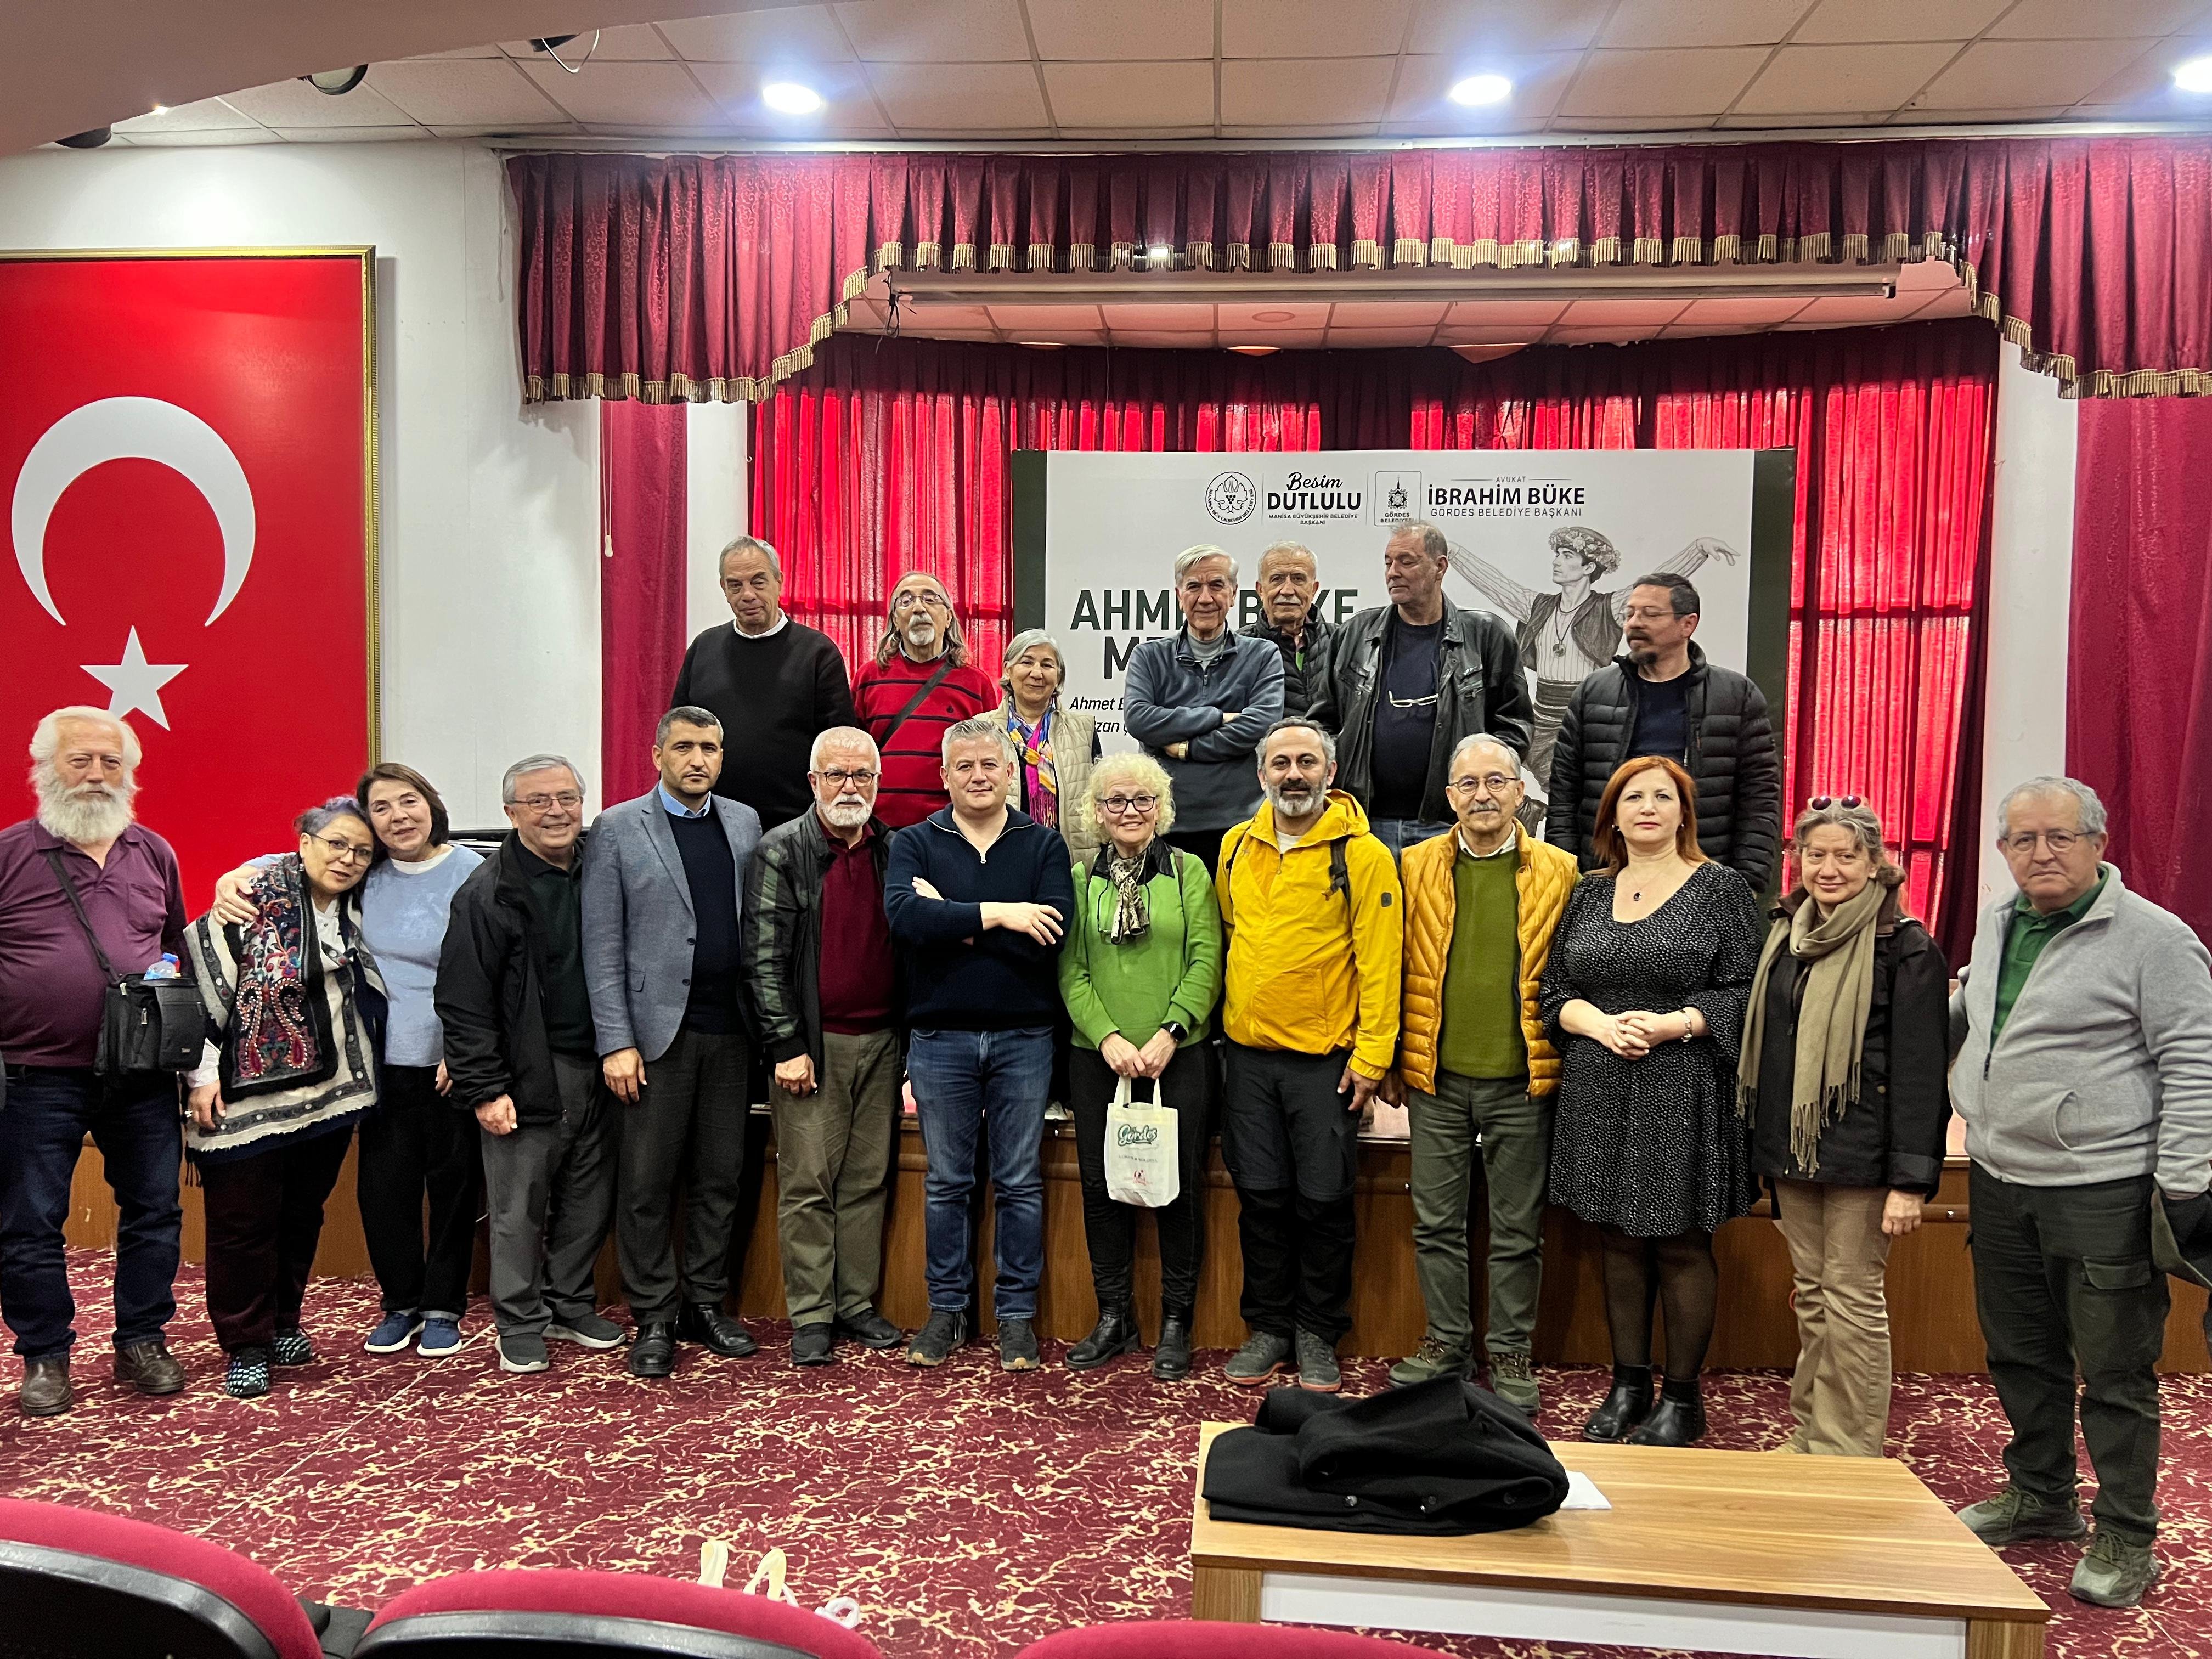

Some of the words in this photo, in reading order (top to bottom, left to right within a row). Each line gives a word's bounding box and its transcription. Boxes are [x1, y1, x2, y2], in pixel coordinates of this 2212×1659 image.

[1286, 472, 1343, 490] Besim
[1267, 492, 1361, 510] DUTLULU
[1428, 484, 1521, 505] İBRAHİM
[1528, 484, 1585, 505] BÜKE
[1431, 506, 1475, 517] GÖRDES
[1478, 506, 1531, 517] BELEDİYE
[1534, 507, 1582, 518] BAŞKANI
[1070, 590, 1185, 630] AHM
[1069, 696, 1116, 710] Ahmet
[1095, 721, 1120, 732] zan
